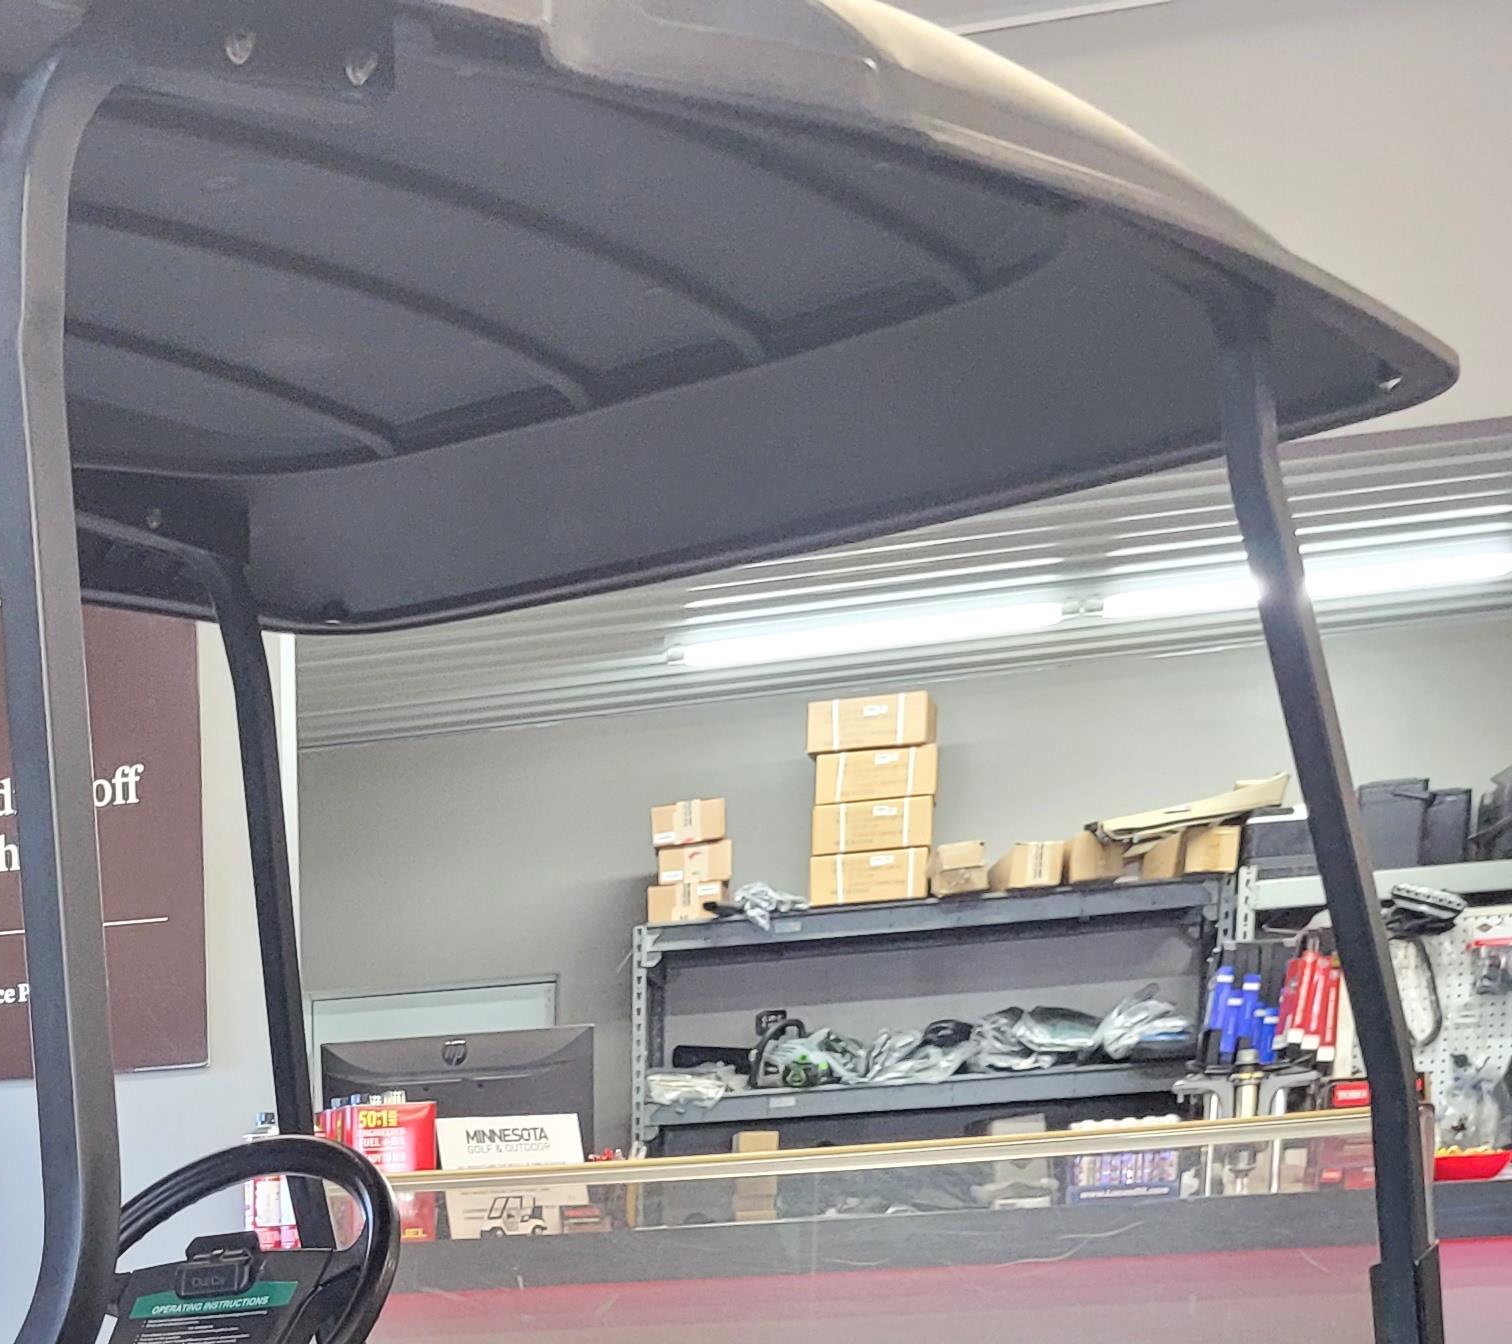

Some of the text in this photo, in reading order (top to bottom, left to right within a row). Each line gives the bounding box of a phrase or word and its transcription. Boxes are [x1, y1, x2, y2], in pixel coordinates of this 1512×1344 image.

[92, 764, 144, 807] off
[358, 1109, 388, 1128] 50:1
[465, 1127, 549, 1144] MINNESOTA
[467, 1142, 550, 1154] GOLF & OUTDOOR
[151, 1296, 270, 1315] OPERATING INSTRUCTIONS
